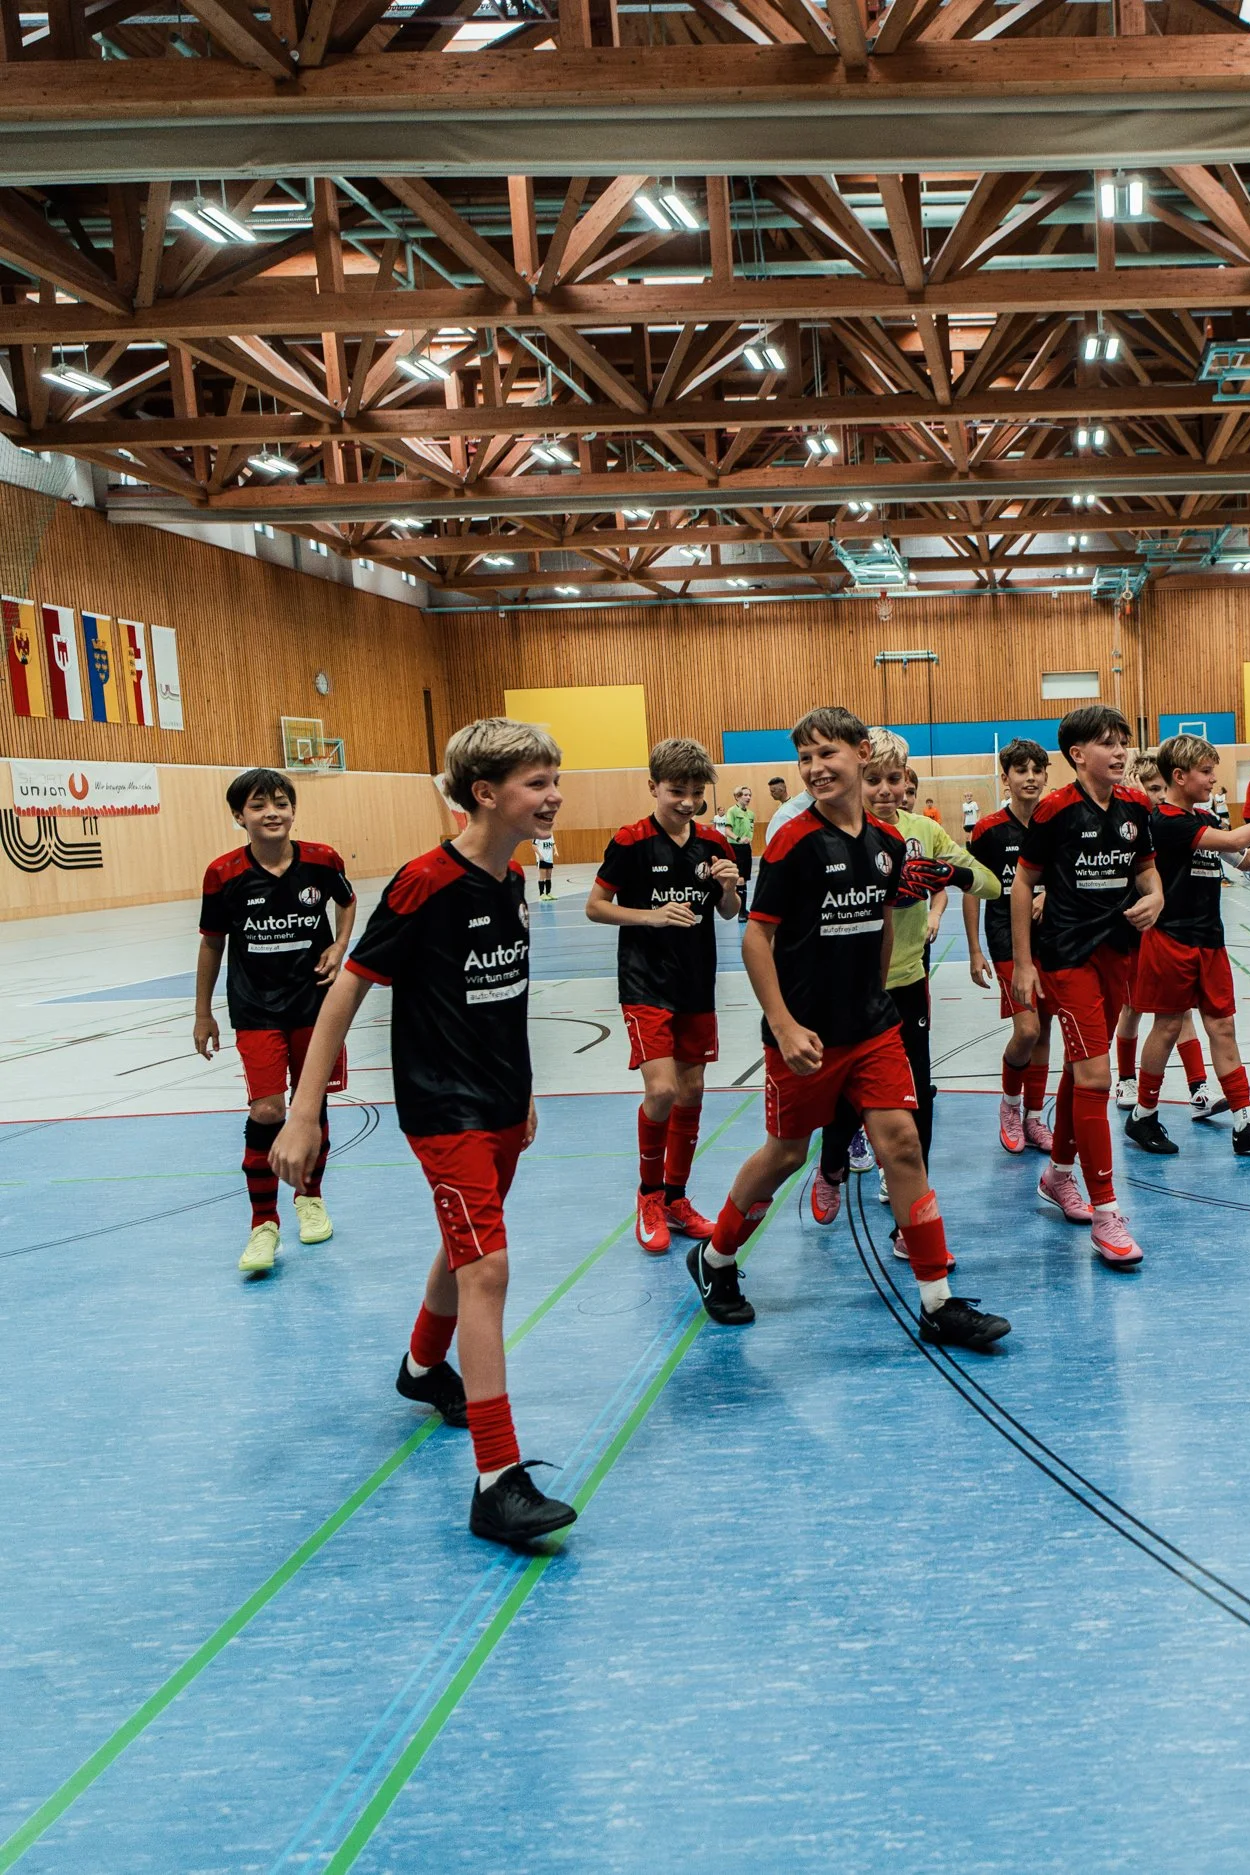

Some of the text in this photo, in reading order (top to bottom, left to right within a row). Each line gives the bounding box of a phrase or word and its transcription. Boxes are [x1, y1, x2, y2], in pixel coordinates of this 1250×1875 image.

[20, 785, 67, 797] union
[1075, 849, 1136, 867] AutoFrey
[825, 863, 847, 874] JAKO
[1075, 869, 1087, 877] Wir
[1088, 869, 1100, 877] tun
[247, 898, 266, 907] JAKO
[837, 911, 853, 919] tun
[243, 913, 321, 931] AutoFrey
[468, 915, 491, 929] JAKO
[257, 933, 273, 941] tun
[485, 973, 503, 983] tun
